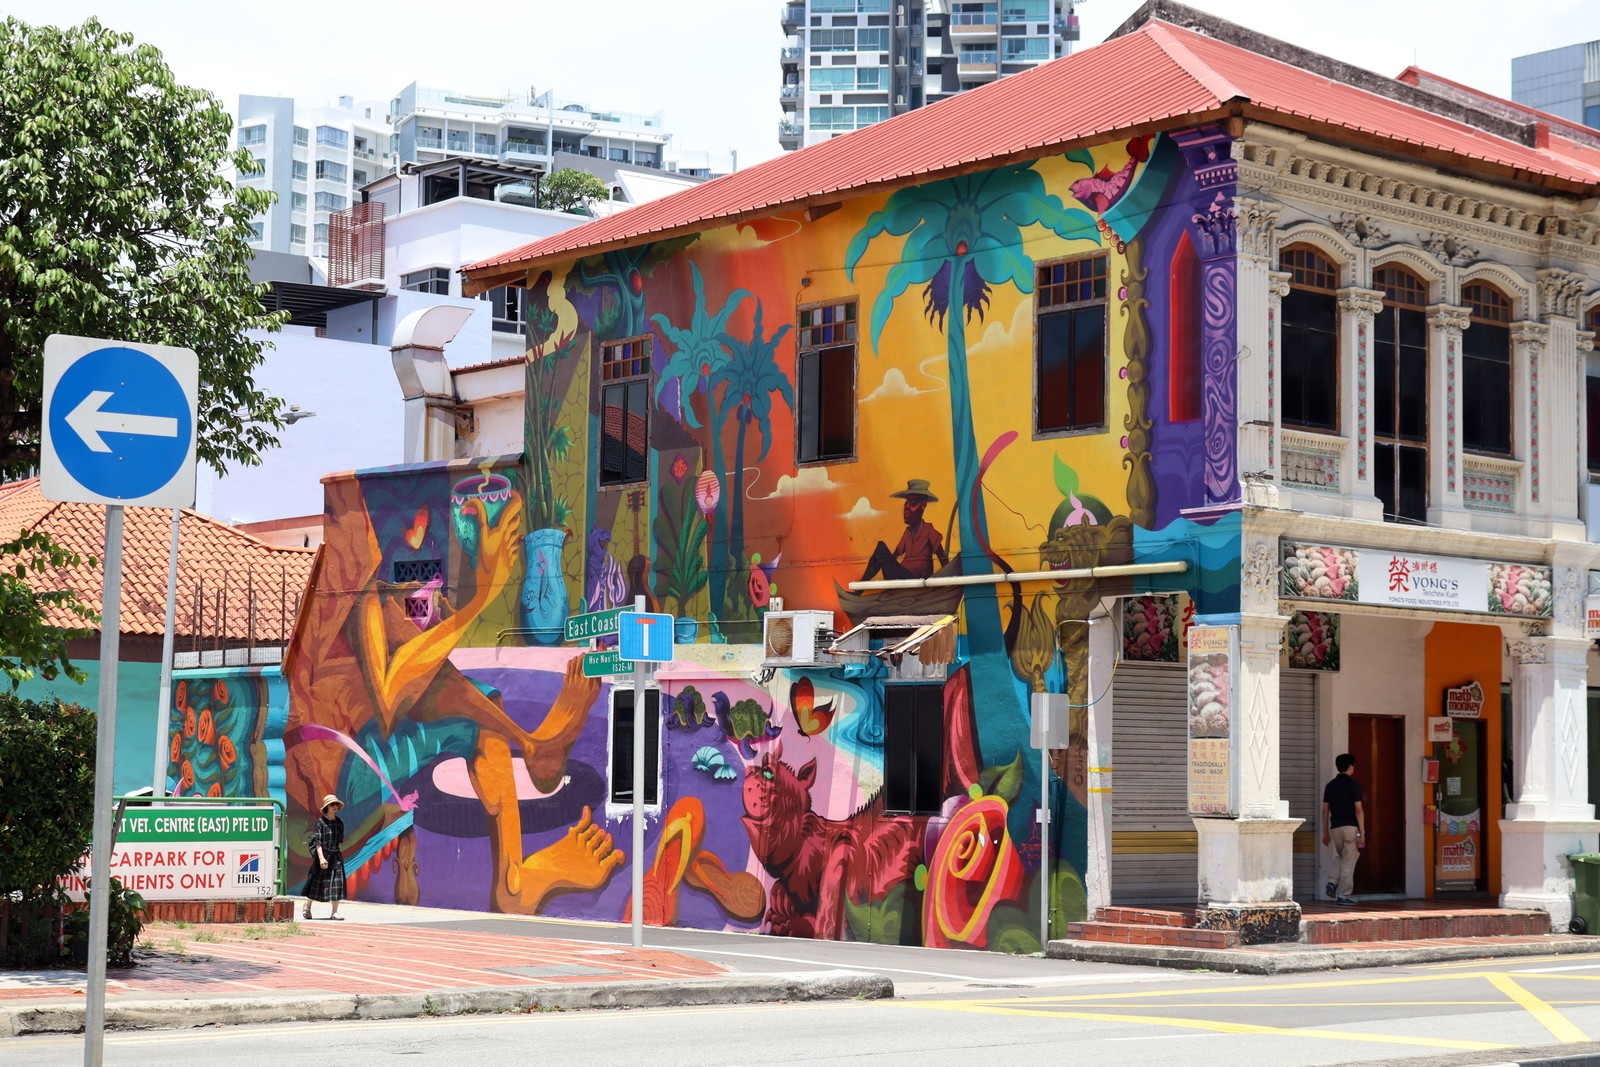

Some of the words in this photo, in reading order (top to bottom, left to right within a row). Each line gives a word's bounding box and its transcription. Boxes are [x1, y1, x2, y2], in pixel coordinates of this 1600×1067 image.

[1412, 576, 1459, 591] YONG'S
[1422, 588, 1445, 598] Teochew
[1446, 591, 1459, 599] Kueh
[568, 620, 588, 637] East
[591, 615, 618, 633] Coast
[588, 656, 599, 665] Hse
[600, 654, 611, 664] Nos
[612, 661, 633, 672] 152E-M
[1449, 689, 1472, 702] math
[1448, 701, 1481, 715] monkey
[129, 817, 152, 833] VET.
[154, 817, 195, 833] CENTRE
[197, 816, 230, 833] (EAST)
[232, 817, 249, 832] PTE
[251, 817, 269, 832] LTD
[1443, 843, 1465, 857] math
[109, 851, 187, 868] CARPARK
[193, 850, 225, 866] FOR
[1443, 856, 1472, 867] monkey
[180, 873, 226, 889] ONLY
[237, 873, 261, 884] Hill's
[256, 886, 272, 895] 152
